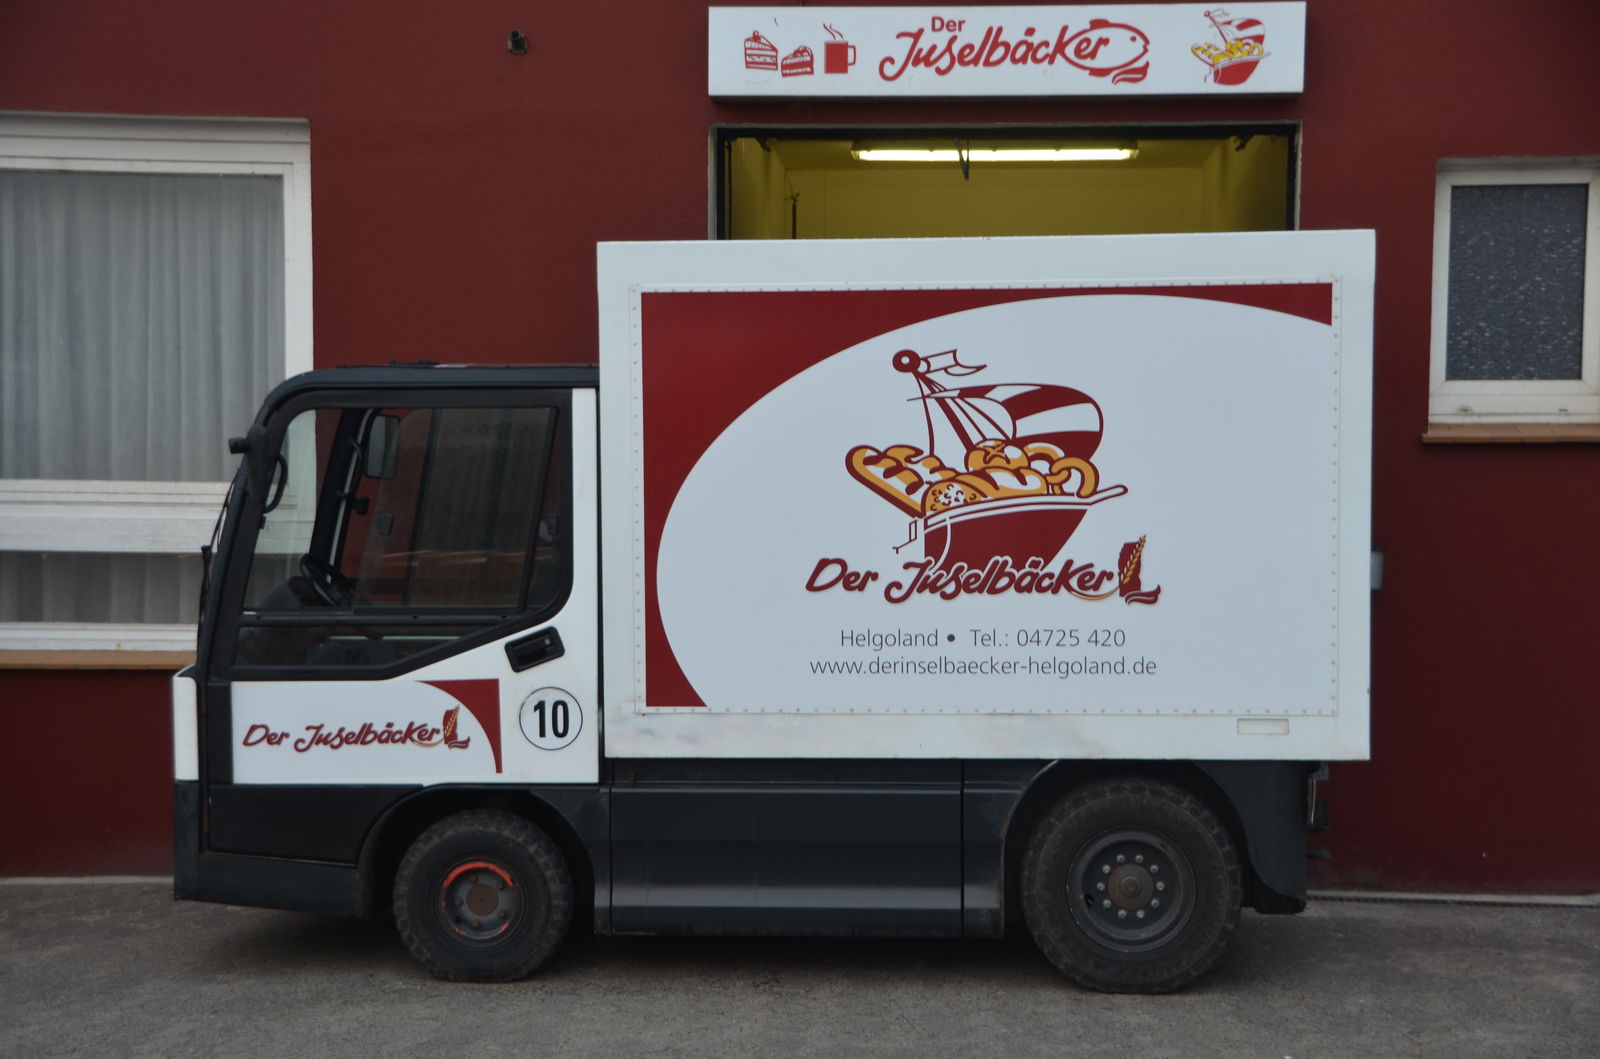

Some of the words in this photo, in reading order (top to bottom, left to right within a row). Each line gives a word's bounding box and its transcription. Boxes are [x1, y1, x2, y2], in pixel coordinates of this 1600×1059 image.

[931, 16, 966, 33] Der
[805, 557, 879, 593] Der
[840, 628, 939, 651] Helgoland
[969, 628, 1009, 648] Tel.:
[1016, 628, 1081, 648] 04725
[1087, 628, 1126, 648] 420
[810, 656, 1157, 680] www.derinselbaecker-helgoland.de
[533, 700, 570, 739] 10
[243, 724, 291, 747] Der
